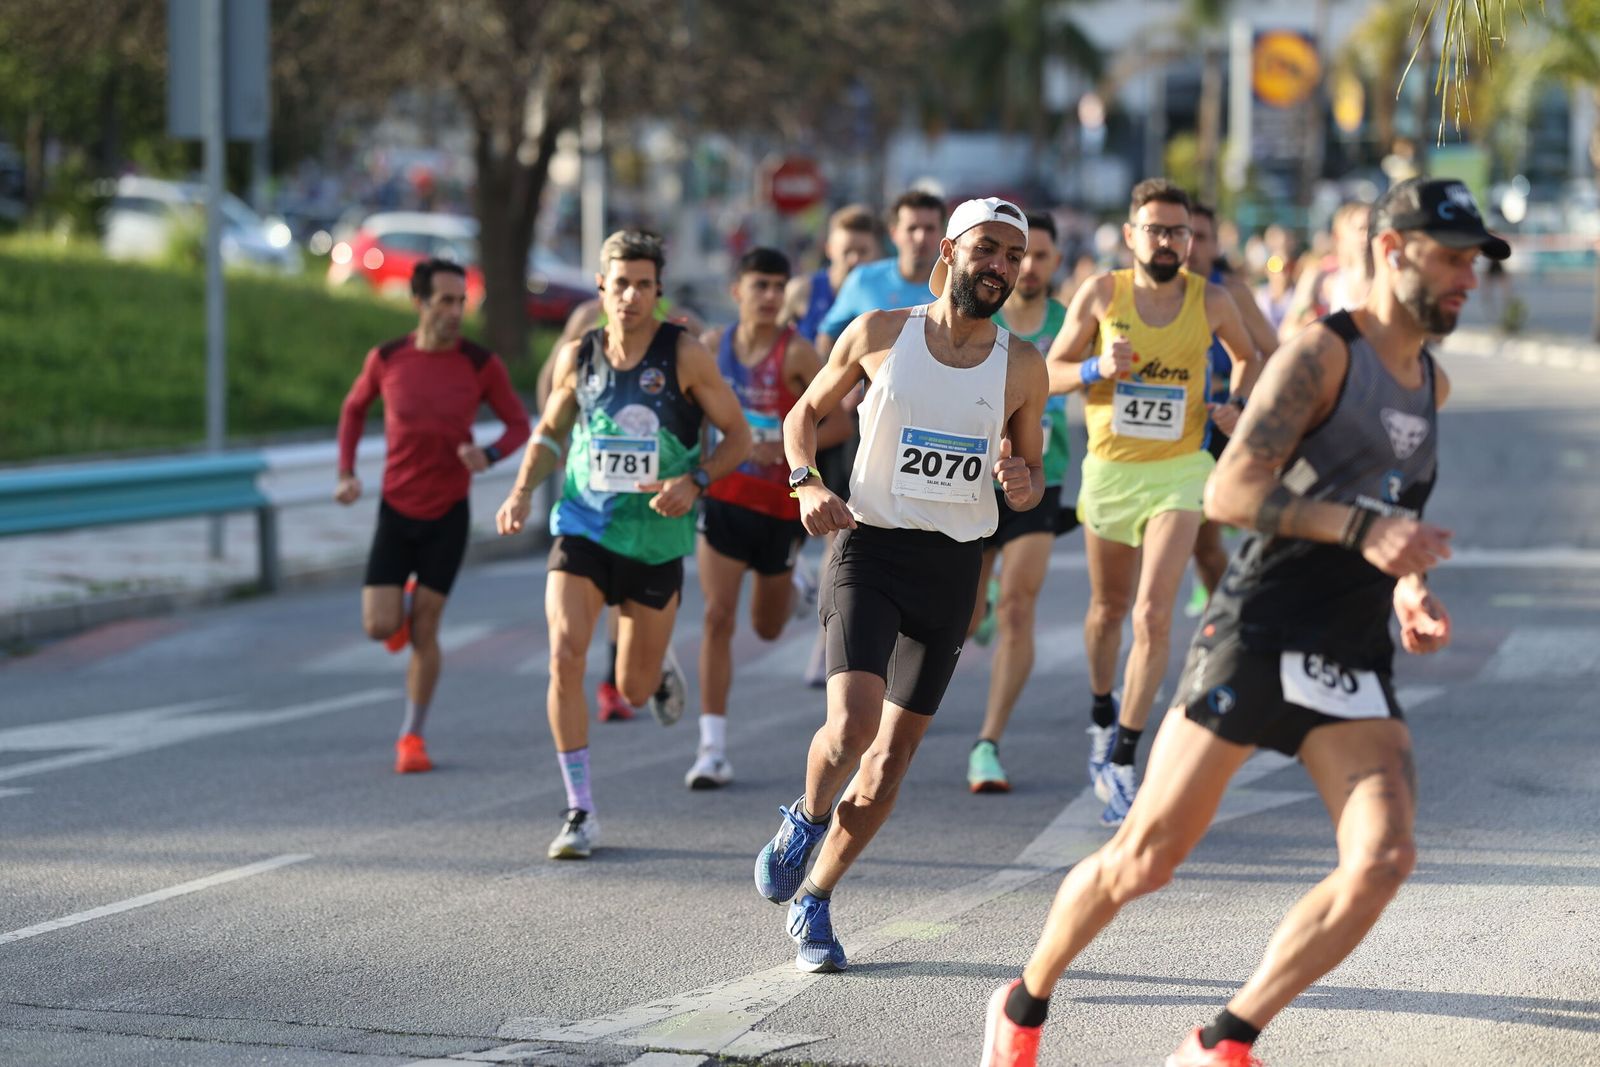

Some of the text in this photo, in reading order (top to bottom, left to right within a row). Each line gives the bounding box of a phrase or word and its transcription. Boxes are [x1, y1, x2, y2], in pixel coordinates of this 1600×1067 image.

[1124, 400, 1172, 421] 475
[595, 453, 650, 474] 1781
[900, 448, 982, 481] 2070
